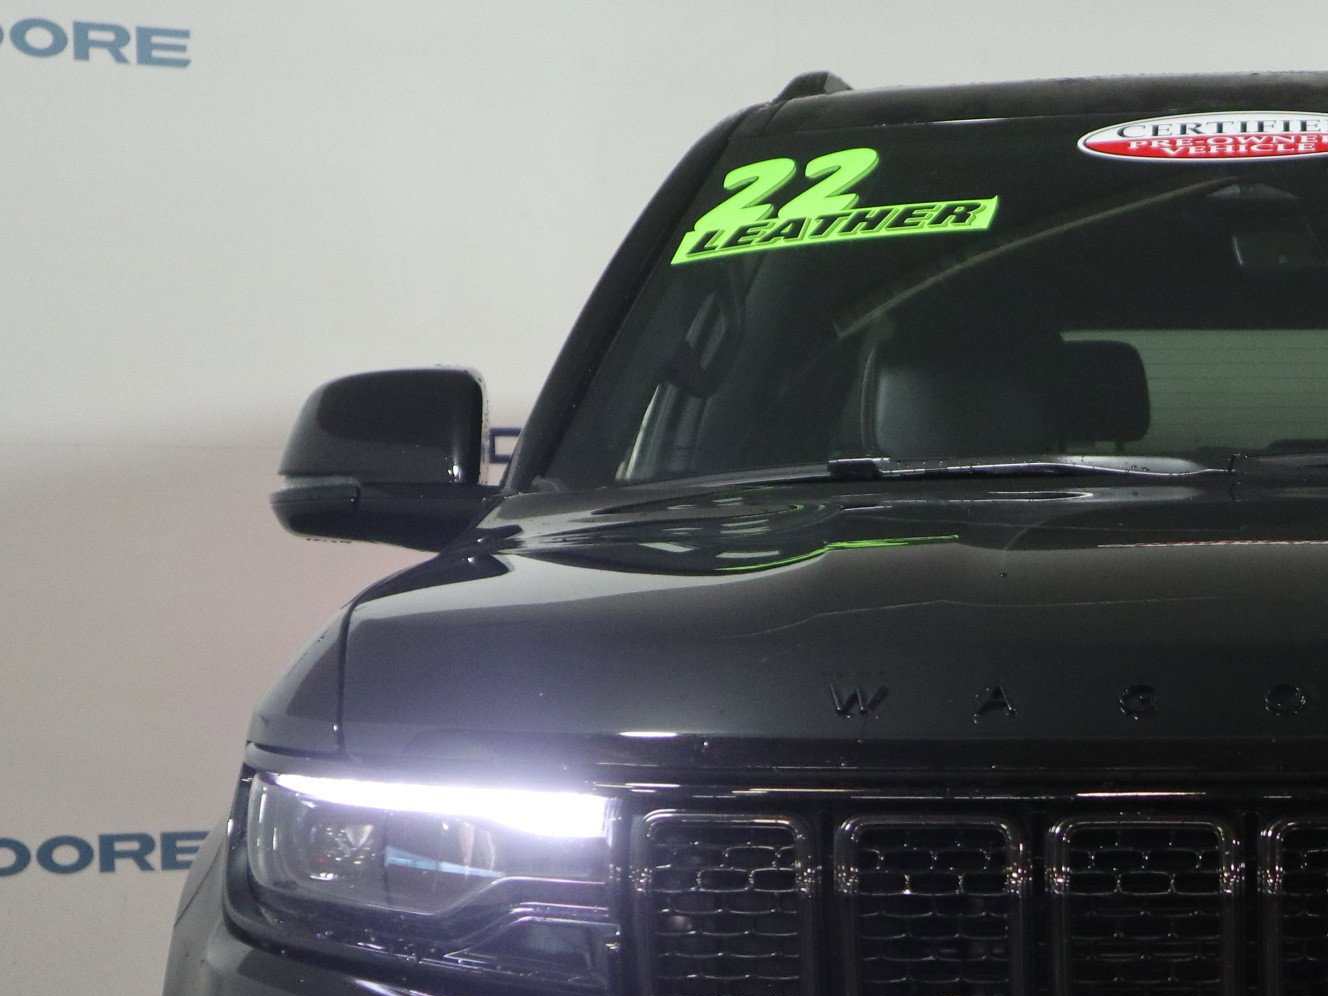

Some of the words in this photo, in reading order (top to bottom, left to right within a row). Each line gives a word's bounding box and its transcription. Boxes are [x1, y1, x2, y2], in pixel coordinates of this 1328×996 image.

[0, 18, 191, 68] ORE
[1160, 143, 1316, 157] VEHICLE
[694, 147, 880, 233] 22
[686, 201, 985, 258] LEATHER
